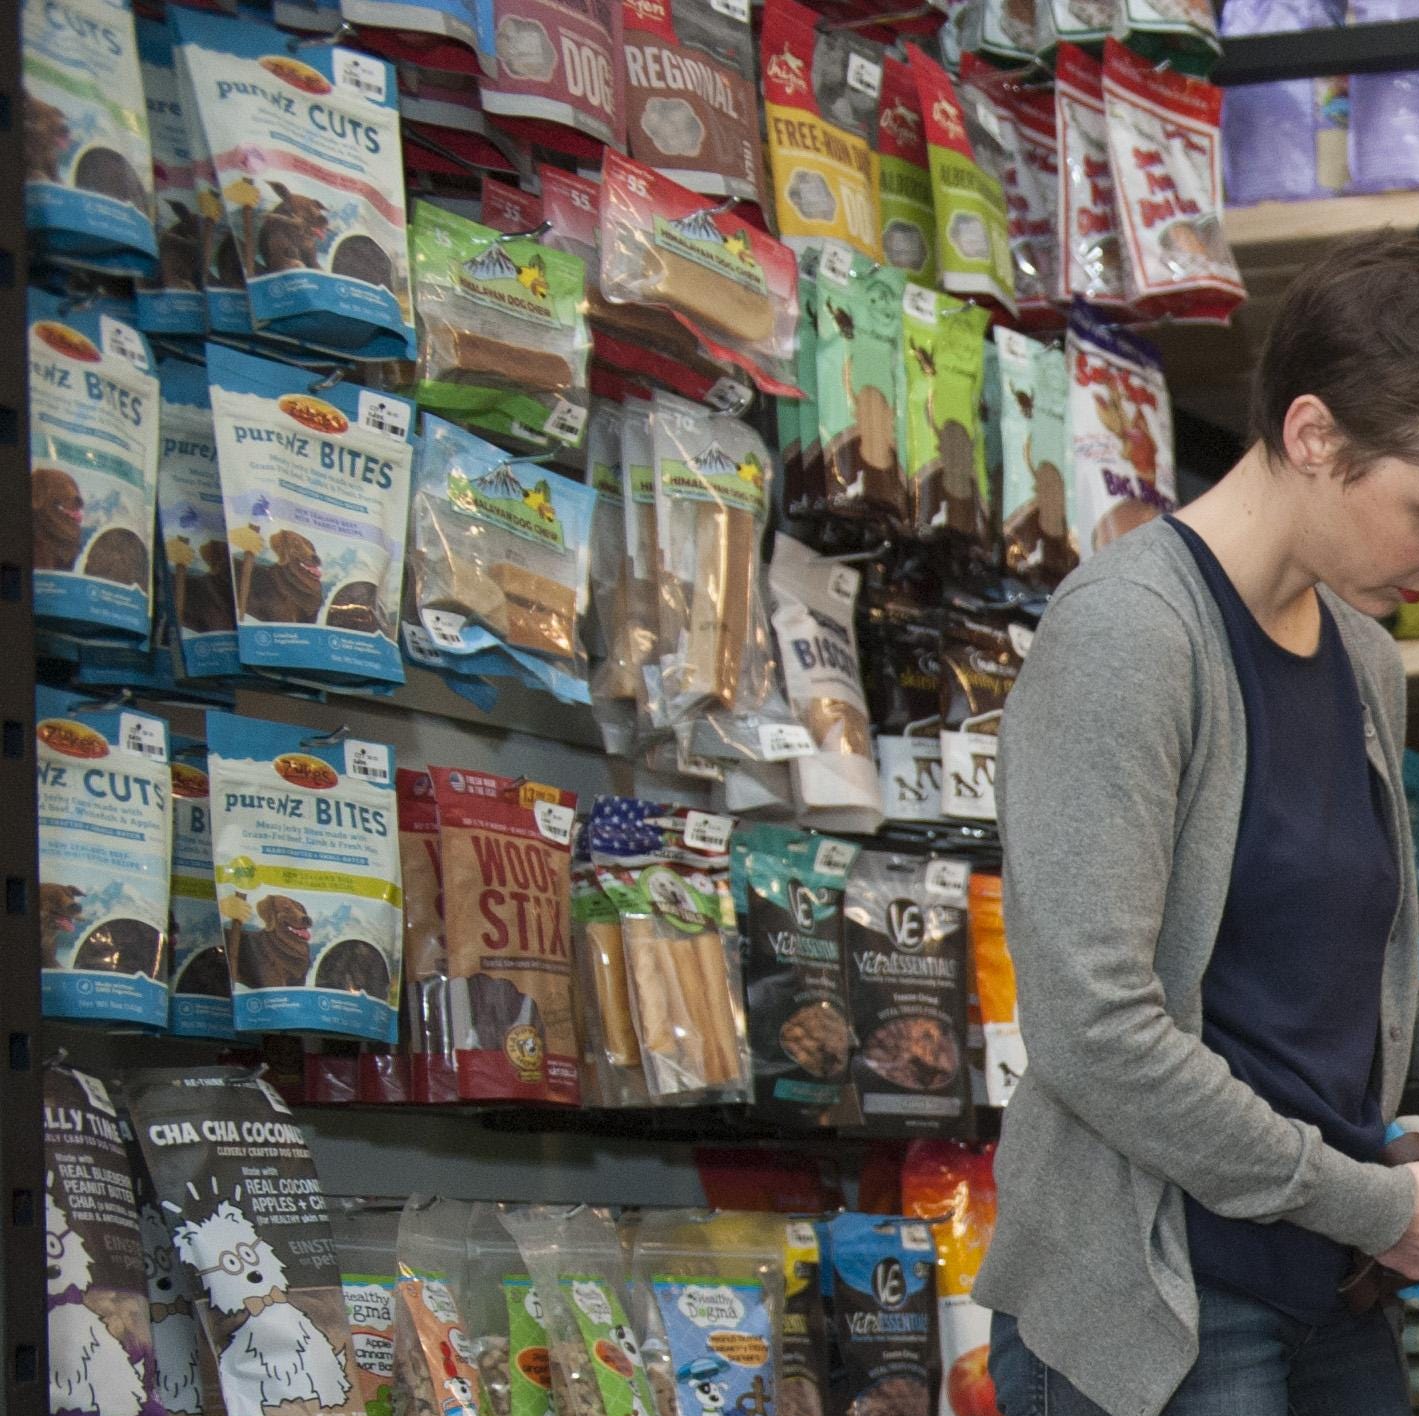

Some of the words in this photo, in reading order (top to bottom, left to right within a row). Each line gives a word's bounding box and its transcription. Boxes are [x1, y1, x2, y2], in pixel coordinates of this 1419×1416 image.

[624, 46, 738, 118] REGIONAL
[308, 105, 381, 154] CUTS
[84, 371, 143, 426] BITES
[319, 441, 394, 490] BITES
[83, 772, 164, 811] CUTS
[316, 799, 387, 837] BITES
[479, 888, 567, 958] STIX
[46, 1108, 83, 1131] LLY
[150, 1121, 200, 1146] CHA
[203, 1120, 240, 1143] CHA
[242, 1121, 305, 1145] COCONU
[59, 1165, 88, 1179] REAL
[64, 1180, 105, 1195] PEANUT
[245, 1179, 277, 1194] REAL
[69, 1195, 96, 1209] CHIA
[252, 1197, 296, 1213] APPLES
